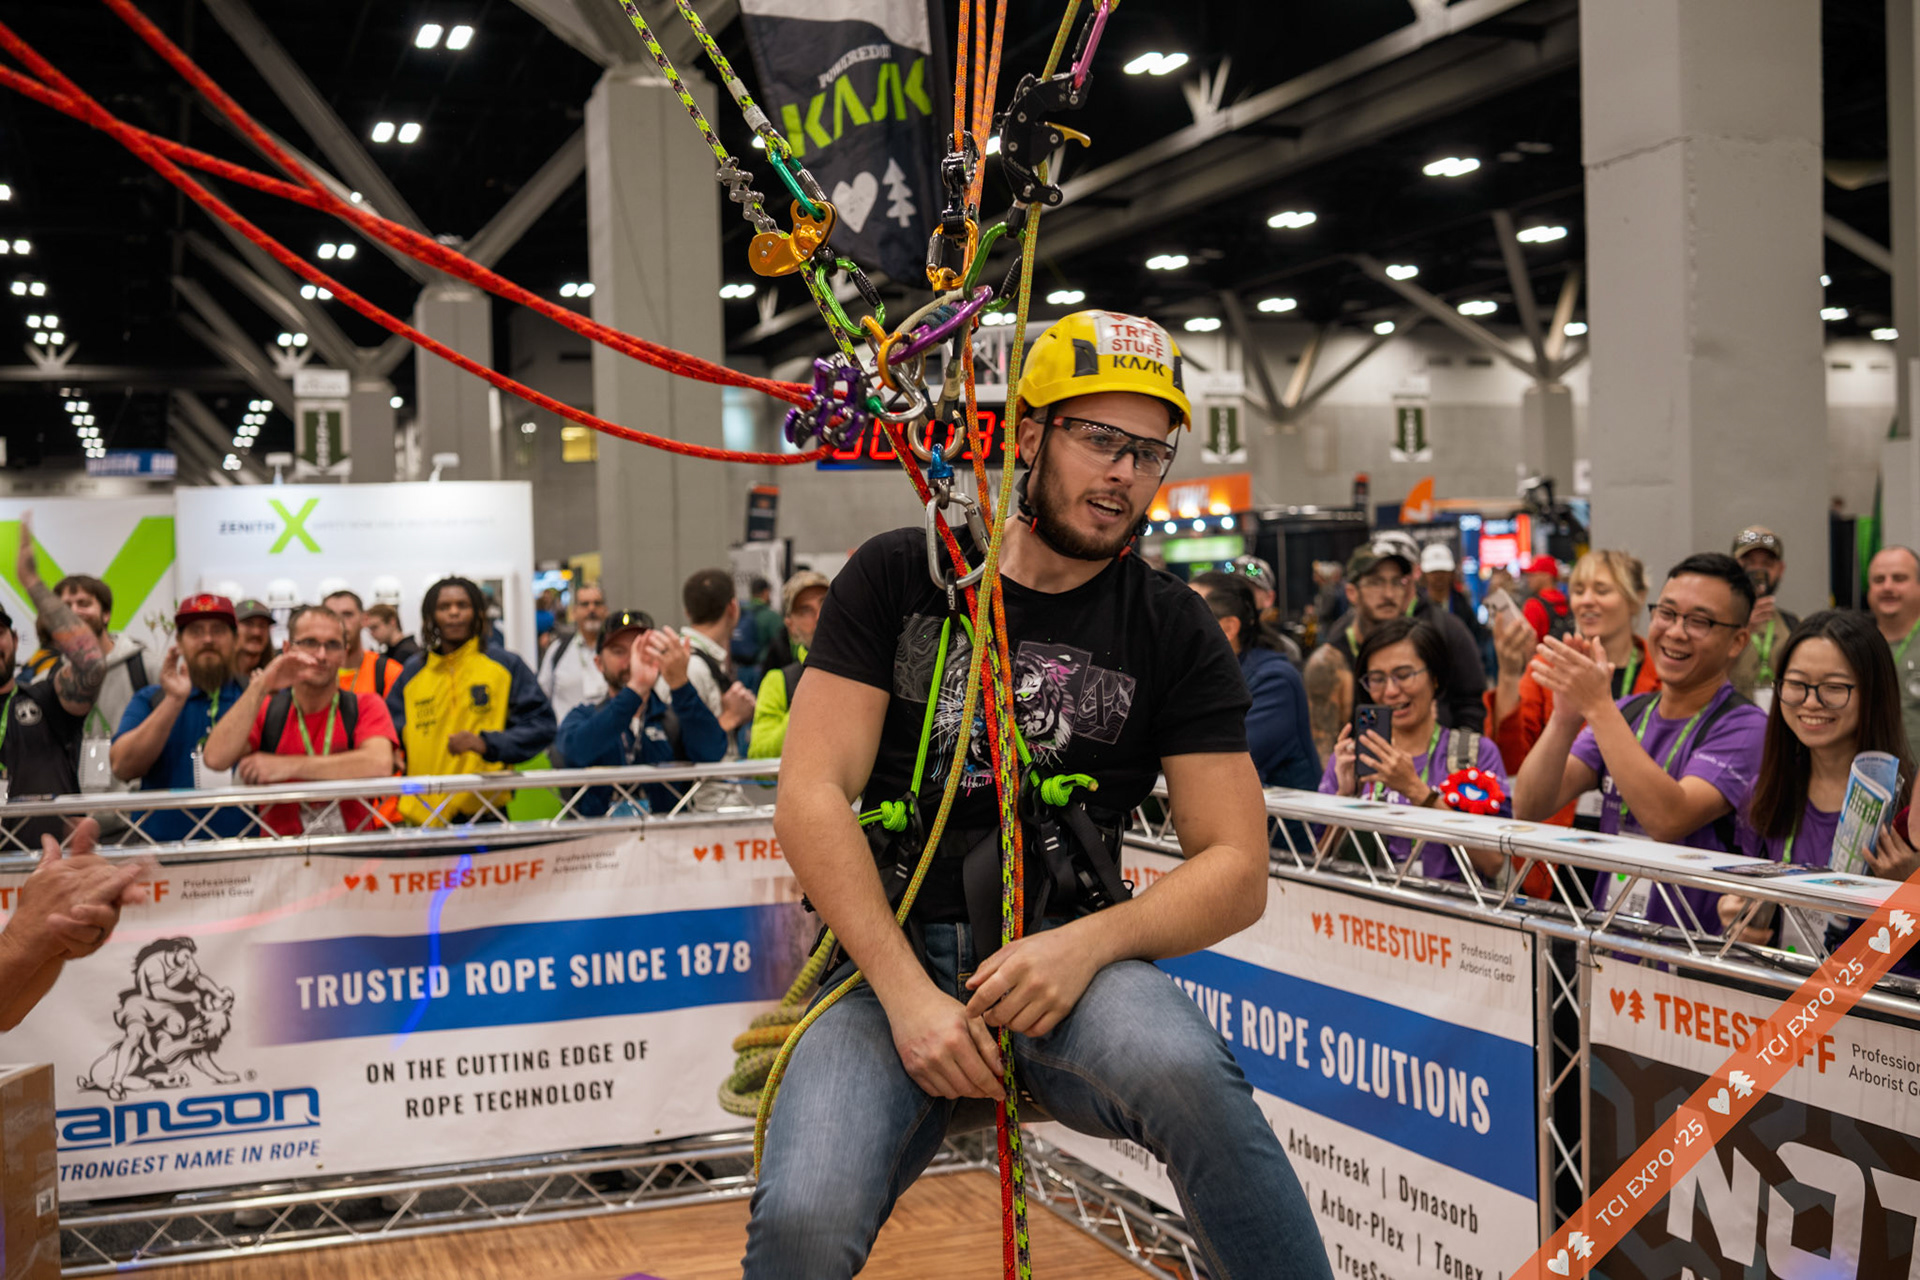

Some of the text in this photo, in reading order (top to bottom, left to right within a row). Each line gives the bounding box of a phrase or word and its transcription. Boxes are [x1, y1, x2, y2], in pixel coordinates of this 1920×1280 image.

[1110, 324, 1163, 347] TREE
[1111, 338, 1164, 359] STUFF
[1113, 355, 1165, 377] KASK
[268, 498, 322, 553] X
[388, 858, 545, 895] TREESTUFF
[1339, 913, 1453, 969] TREESTUFF
[1461, 943, 1513, 966] Professional
[296, 940, 751, 1011] TRUSTED ROPE SINCE 1878
[1460, 961, 1516, 984] Arborist Gear
[1166, 973, 1491, 1135] TIVE ROPE SOLUTIONS
[1653, 992, 1836, 1075] TREESTUFF
[366, 1040, 649, 1084] ON THE CUTTING EDGE OF
[1849, 1064, 1920, 1097] Arborist G
[56, 1086, 320, 1147] amson
[406, 1080, 615, 1119] ROPE TECHNOLOGY
[60, 1139, 320, 1182] TRONGEST NAME IN ROPE
[1289, 1128, 1479, 1234] ArborFreak Dynasorb
[1321, 1189, 1484, 1280] Arbor-Plex Tenex
[1336, 1243, 1395, 1280] TreeS
